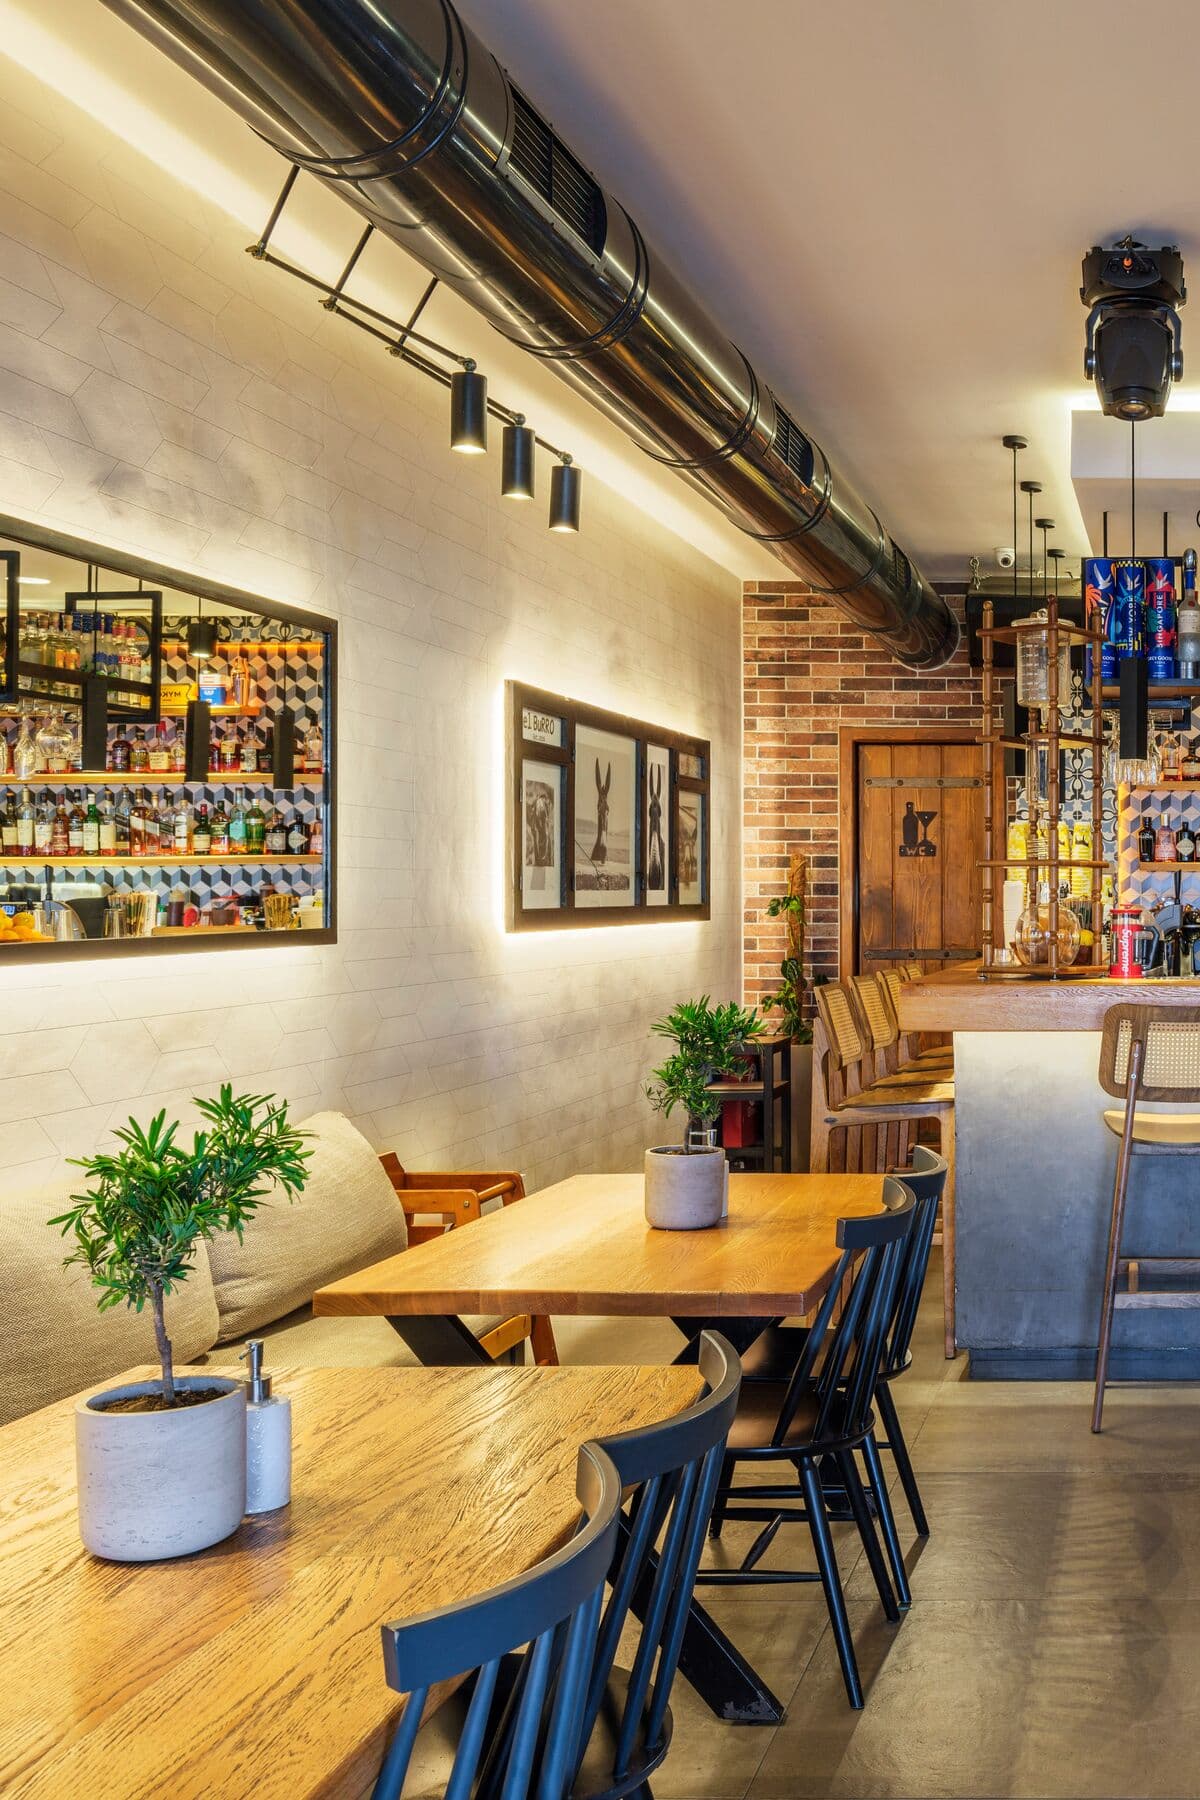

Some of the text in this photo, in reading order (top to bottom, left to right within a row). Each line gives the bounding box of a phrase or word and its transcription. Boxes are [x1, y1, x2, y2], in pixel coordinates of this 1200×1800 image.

[1128, 595, 1137, 651] NEW YORK
[1156, 594, 1164, 648] SINGAPORE
[906, 846, 926, 856] WC
[1120, 929, 1132, 973] Supreme
